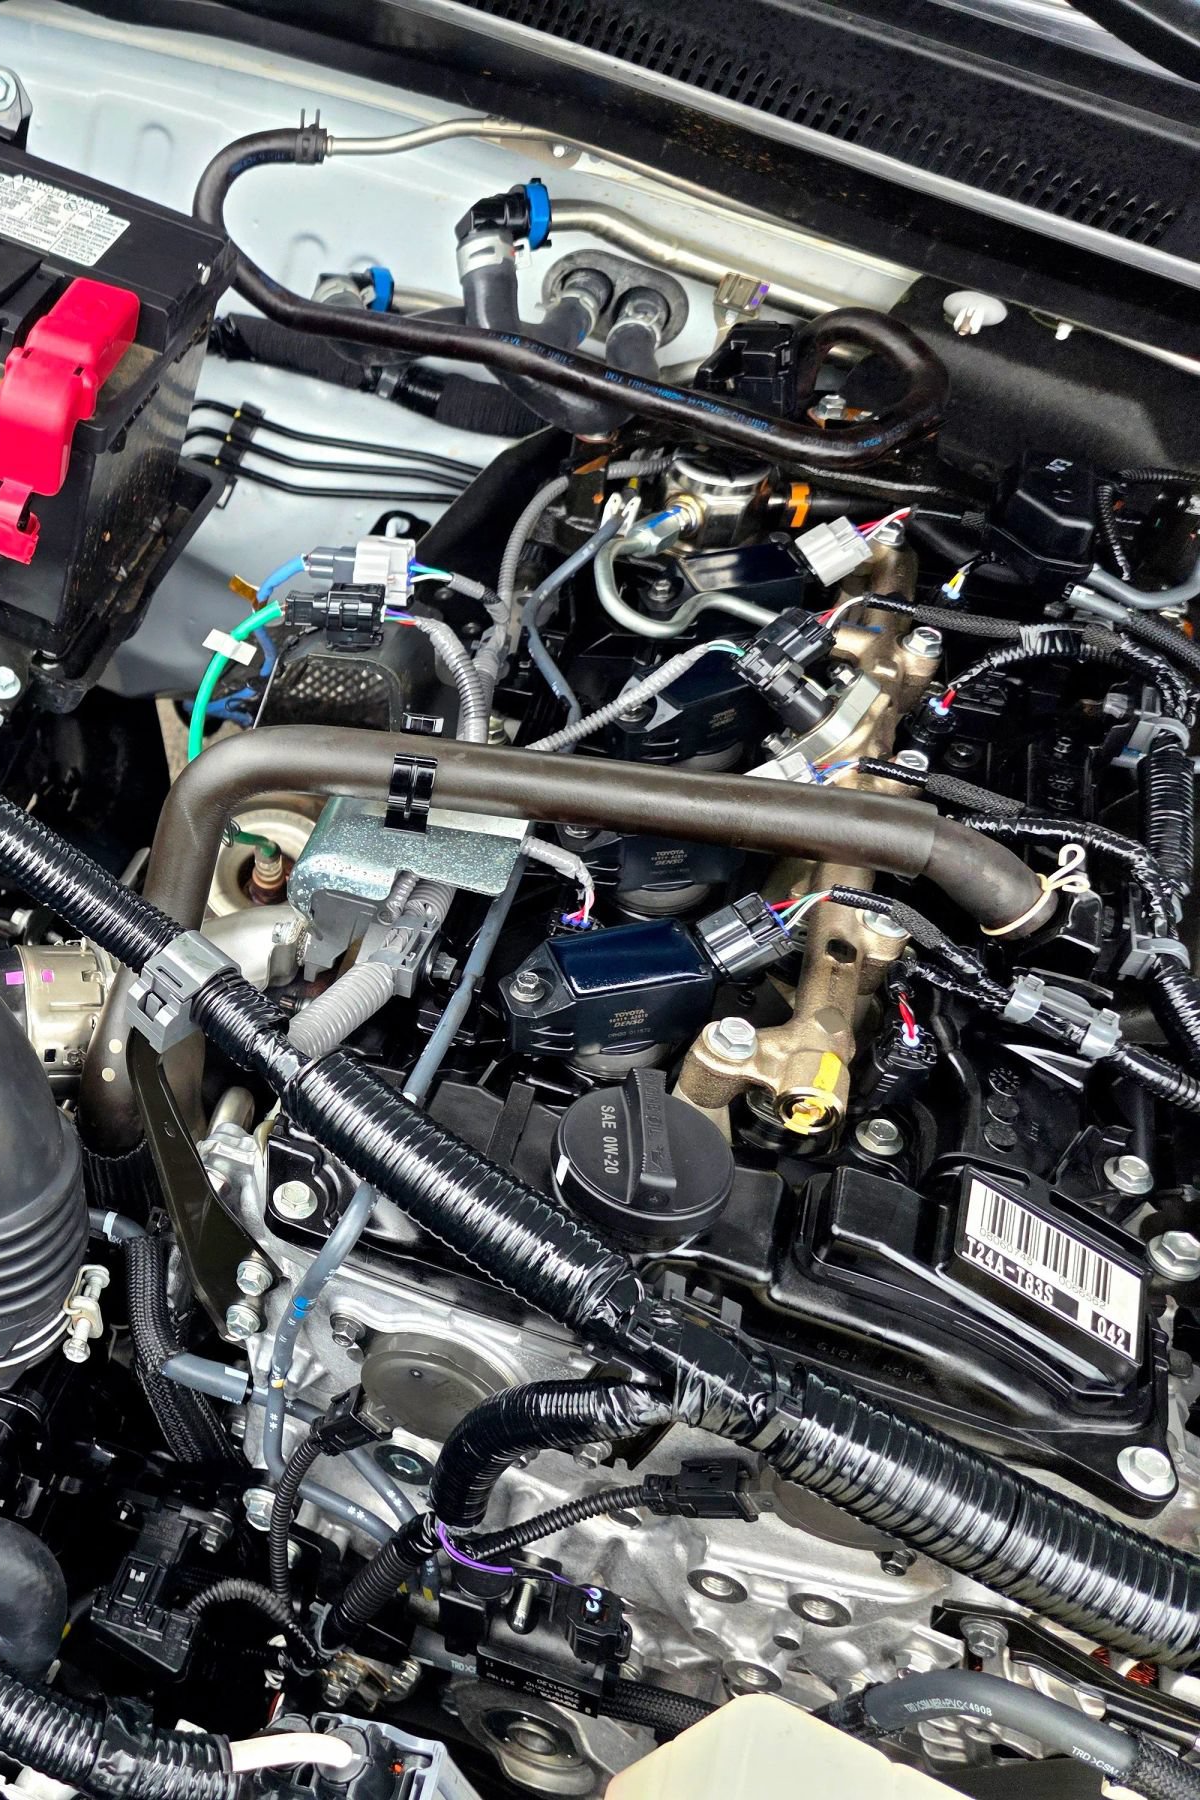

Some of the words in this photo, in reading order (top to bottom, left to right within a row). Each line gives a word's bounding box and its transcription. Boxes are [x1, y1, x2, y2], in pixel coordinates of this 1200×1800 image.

[613, 1008, 645, 1018] TOYOTA
[613, 1018, 645, 1028] DENSO
[600, 1105, 617, 1129] SAE
[602, 1136, 619, 1175] 0W-20
[966, 1236, 1055, 1307] T24A-T83S
[1096, 1316, 1126, 1350] 042
[1072, 1745, 1091, 1762] TRD
